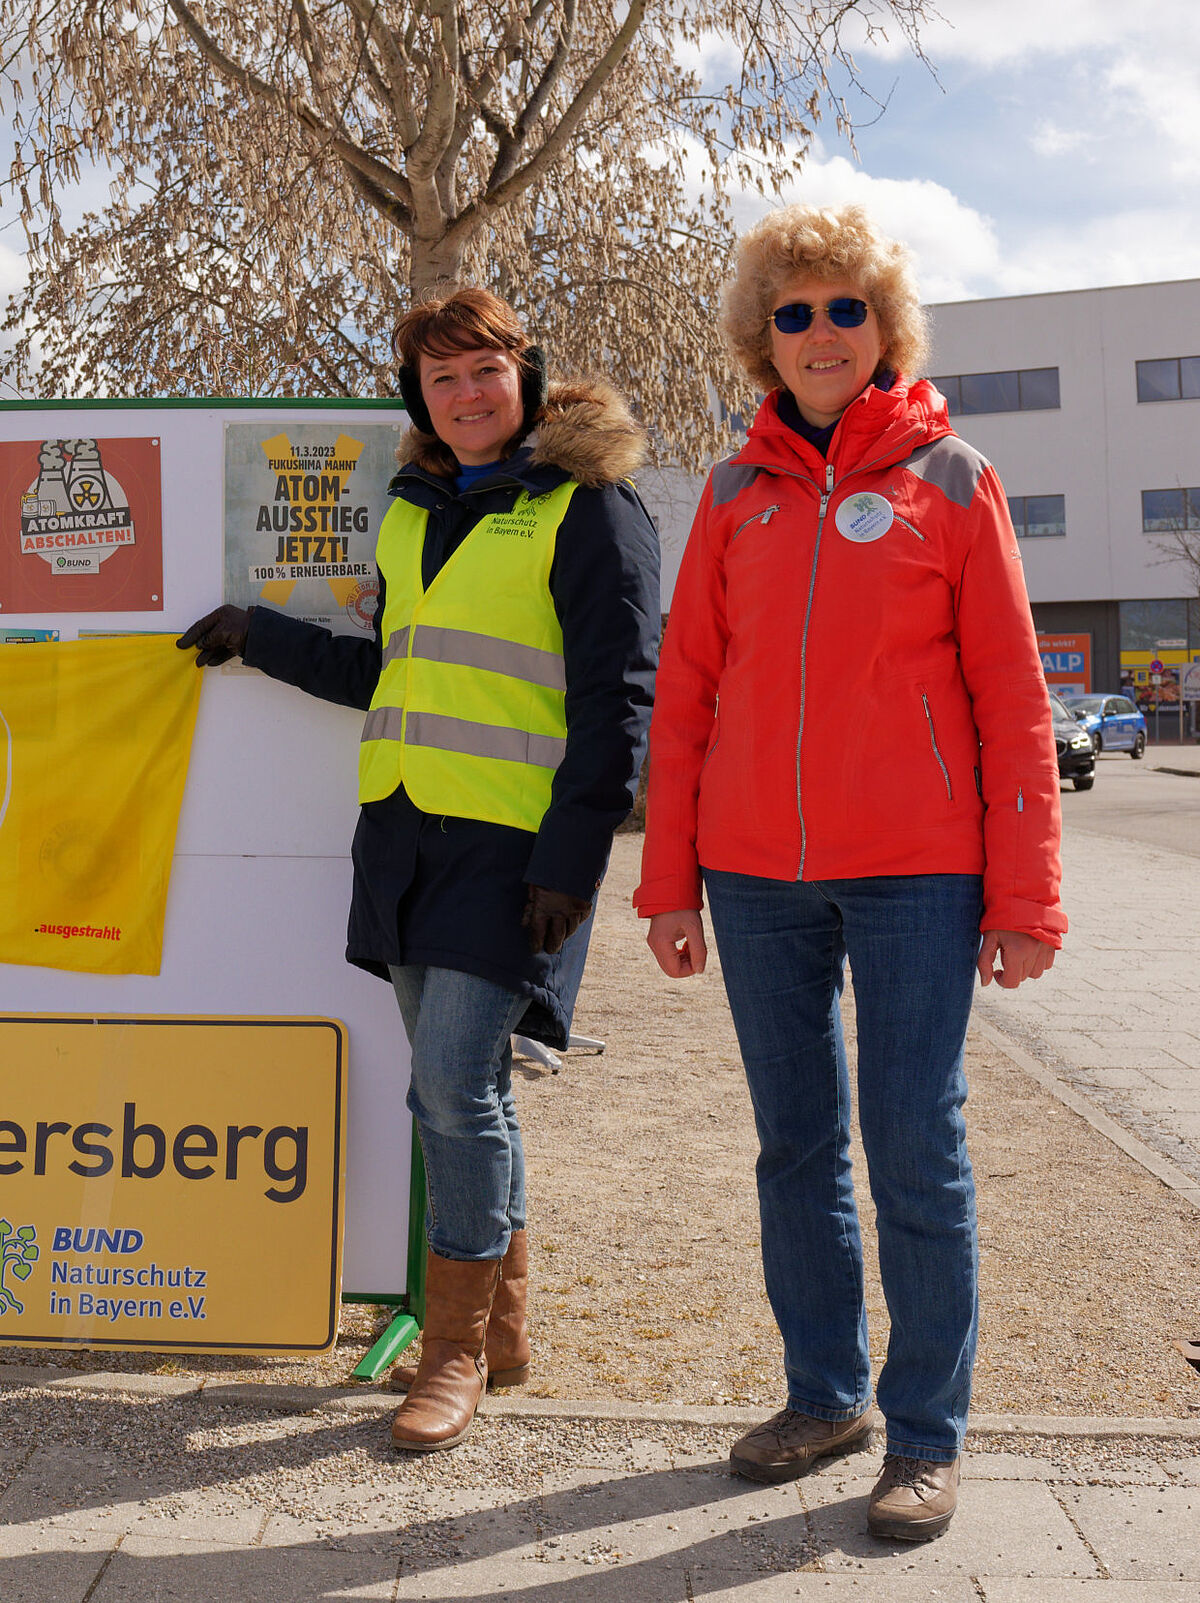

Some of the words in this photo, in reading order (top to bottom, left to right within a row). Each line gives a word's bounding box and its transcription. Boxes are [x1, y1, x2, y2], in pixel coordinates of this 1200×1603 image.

[290, 446, 336, 458] 11.3.2023
[268, 459, 322, 471] FUKUSHIMA
[324, 460, 357, 471] MAHNT
[274, 474, 350, 502] ATOM-
[27, 512, 126, 532] ATOMKRAFT
[256, 505, 369, 532] AUSSTIEG
[492, 518, 538, 528] Naturschutz
[24, 528, 131, 550] ABSCHALTEN!
[494, 526, 519, 536] Bayern
[520, 530, 534, 539] e.V.
[275, 536, 349, 563] JETZT!
[290, 564, 371, 578] ERNEUERBARE.
[34, 923, 122, 941] .ausgestrahlt
[52, 1227, 144, 1254] BUND
[51, 1261, 207, 1289] Naturschutz
[50, 1292, 73, 1315] in
[78, 1294, 162, 1324] Bayern
[169, 1296, 207, 1320] e.V.
